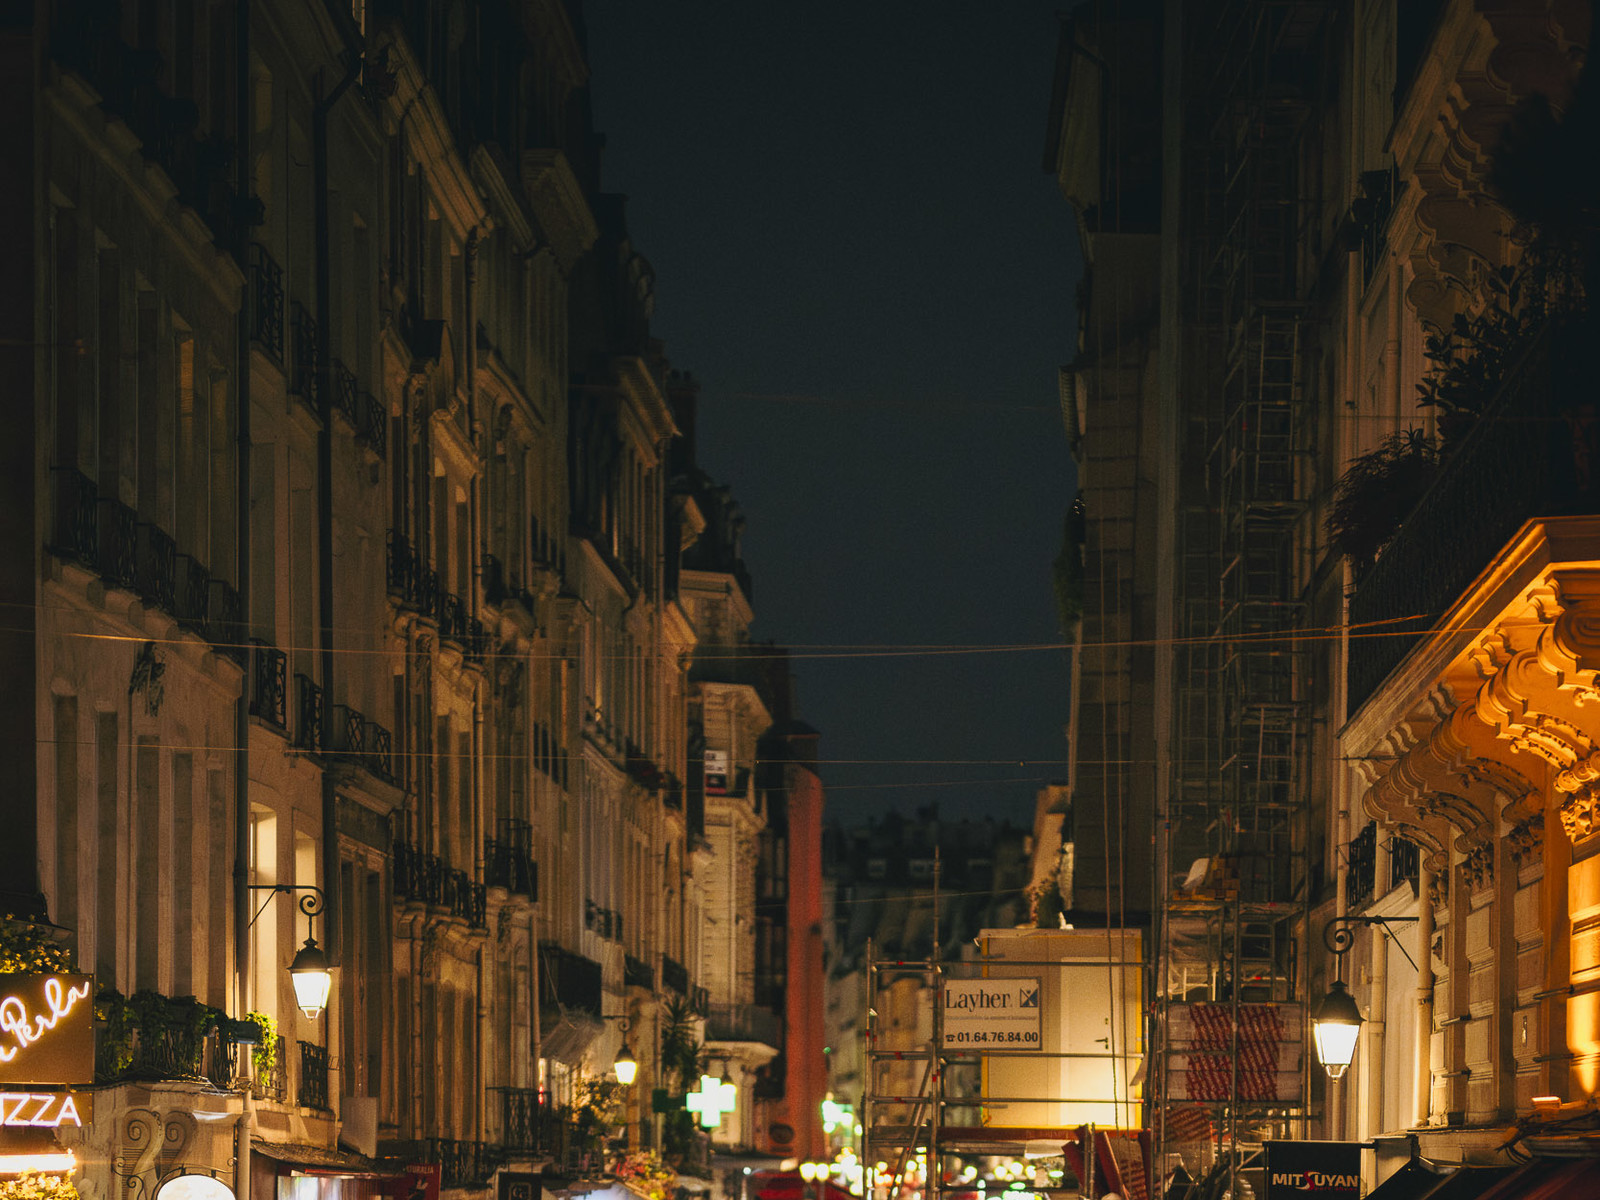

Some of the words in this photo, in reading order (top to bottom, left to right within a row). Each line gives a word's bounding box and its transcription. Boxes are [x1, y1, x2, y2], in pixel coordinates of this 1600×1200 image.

[945, 989, 1011, 1013] Layher
[957, 1031, 1039, 1043] 01.64.76.84.00
[1272, 1170, 1359, 1191] MITSUYAN
